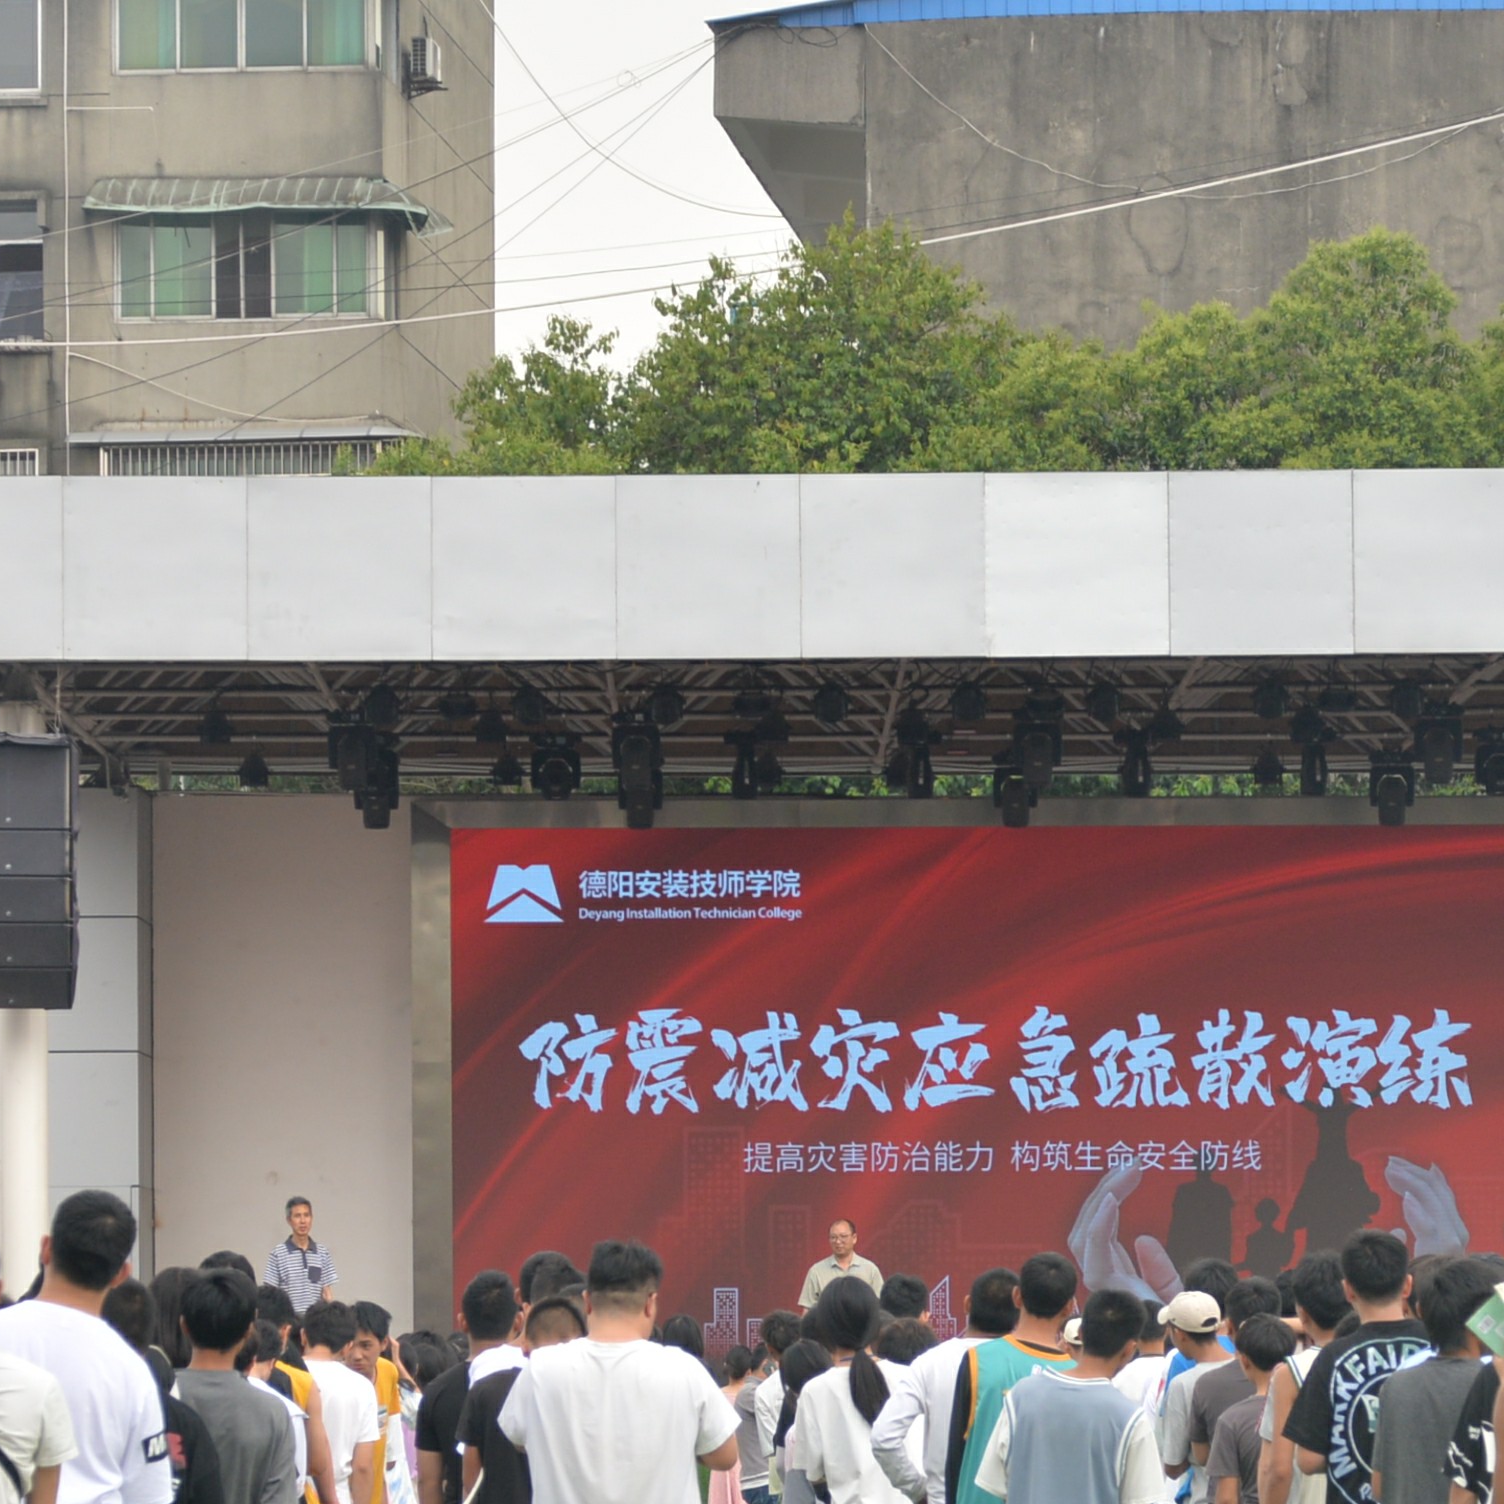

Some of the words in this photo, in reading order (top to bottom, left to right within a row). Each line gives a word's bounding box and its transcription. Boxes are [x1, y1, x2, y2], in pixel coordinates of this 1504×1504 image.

[579, 869, 801, 899] 德阳安装技师学院
[579, 907, 625, 922] Deyang
[626, 907, 692, 920] Installation
[693, 907, 757, 920] Technician
[758, 907, 802, 922] College
[518, 1005, 1473, 1115] 防震减灾应急疏散演练
[743, 1140, 994, 1173] 提高灾害防治能力
[1011, 1139, 1263, 1172] 构筑生命安全防线
